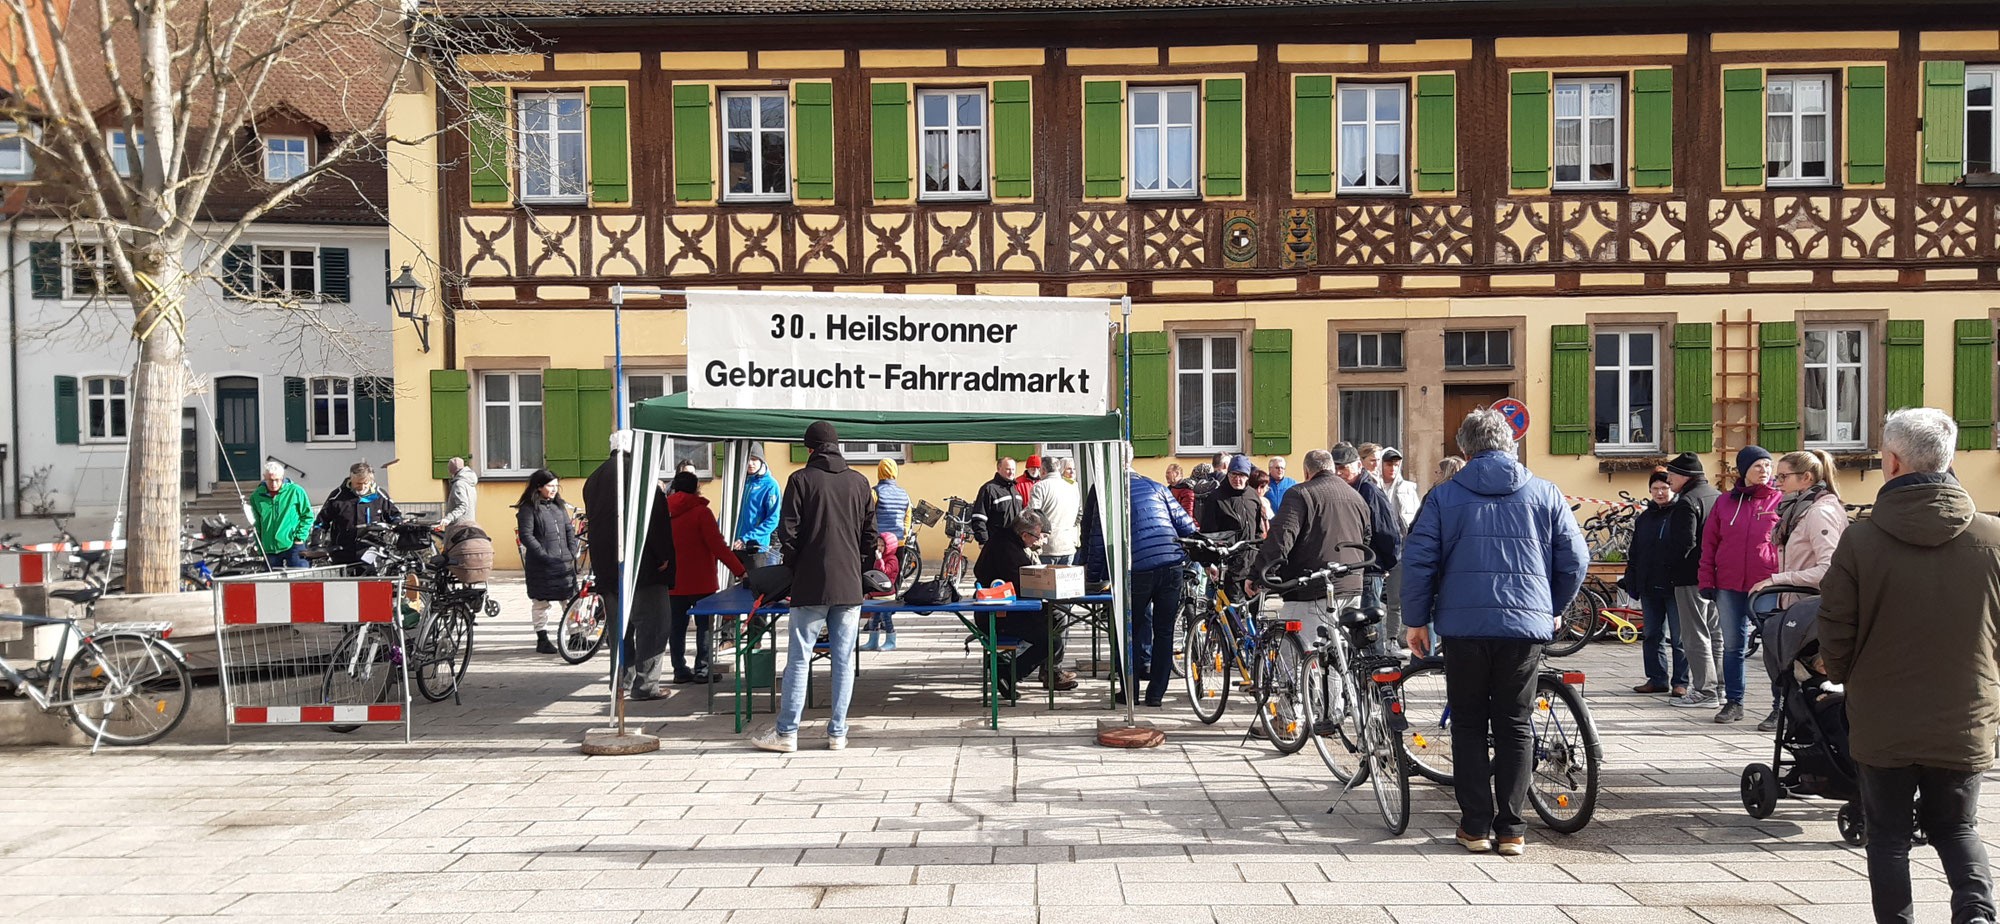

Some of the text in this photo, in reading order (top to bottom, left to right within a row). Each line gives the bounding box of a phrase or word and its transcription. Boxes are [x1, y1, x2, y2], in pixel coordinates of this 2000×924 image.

[771, 313, 1018, 344] 30. Heilsbronner
[705, 359, 1090, 394] Gebraucht-Fahrradmarkt
[1421, 385, 1428, 396] 9
